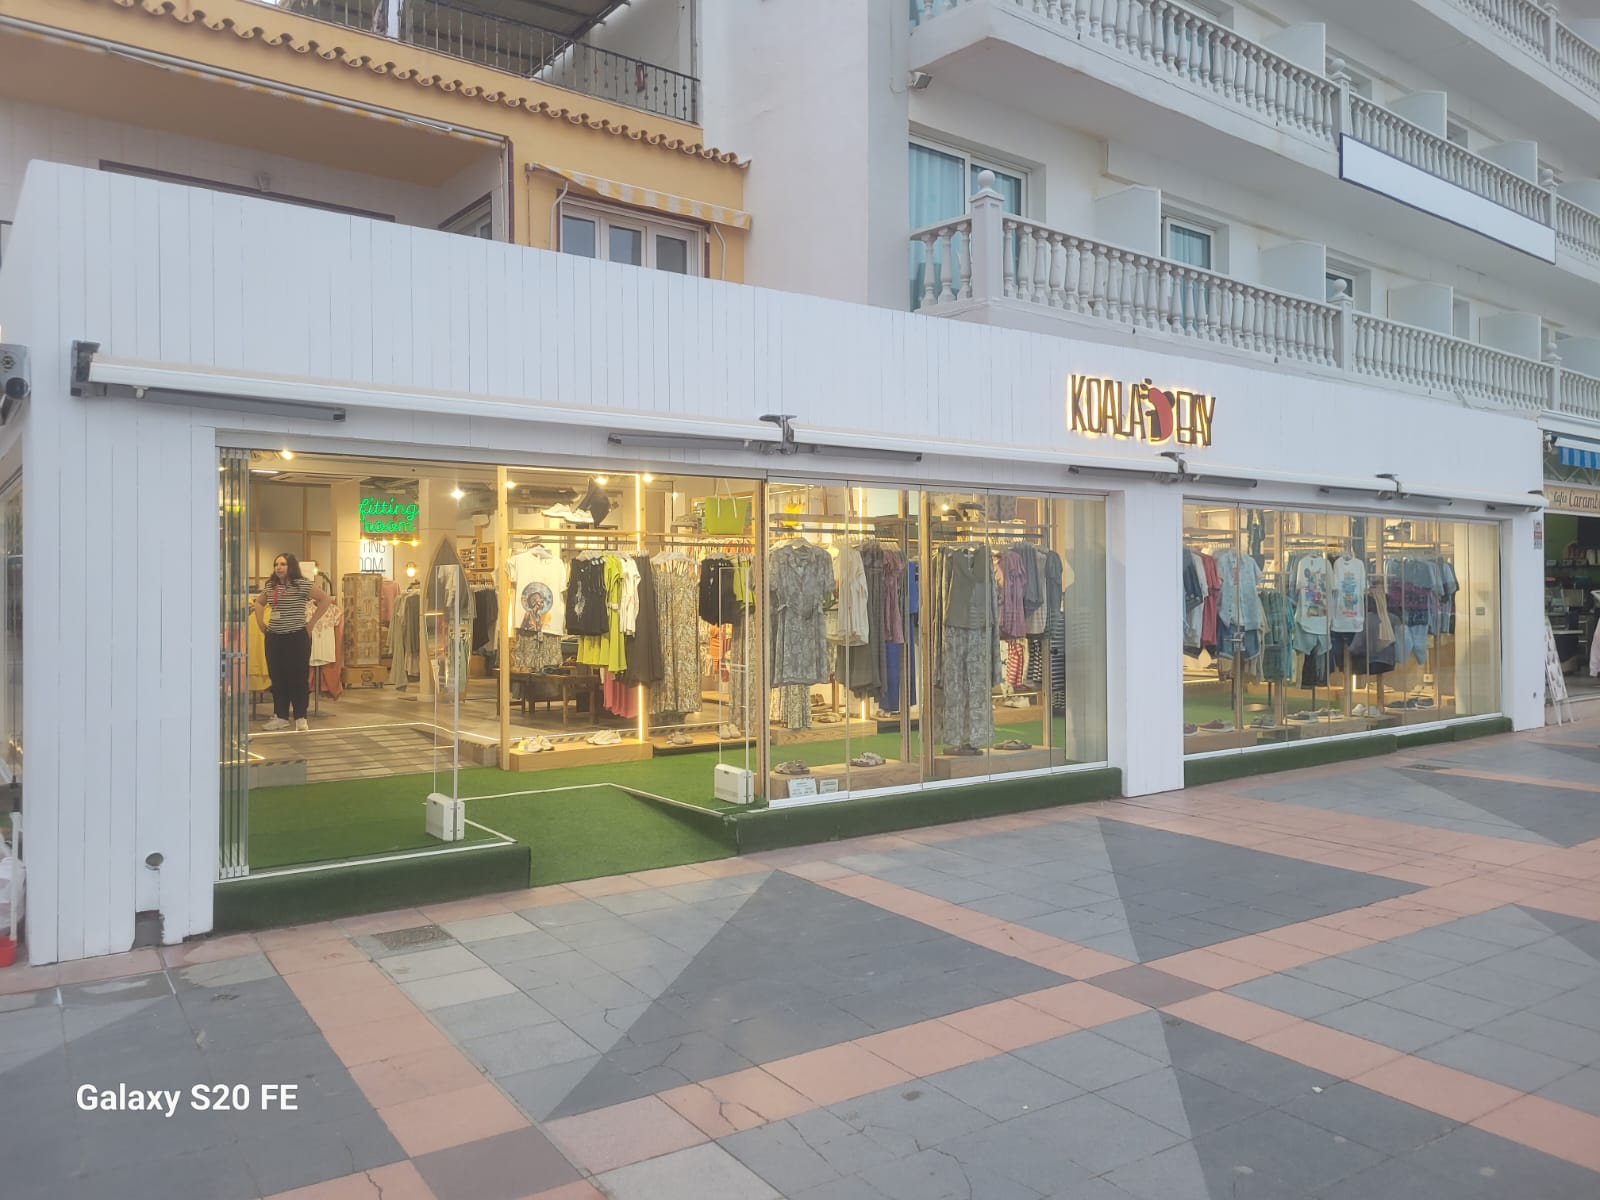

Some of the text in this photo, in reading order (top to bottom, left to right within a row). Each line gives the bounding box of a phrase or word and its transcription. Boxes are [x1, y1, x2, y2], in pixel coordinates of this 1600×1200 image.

[1070, 374, 1216, 446] KOALA BAY
[359, 497, 420, 521] fitting
[363, 519, 416, 533] room
